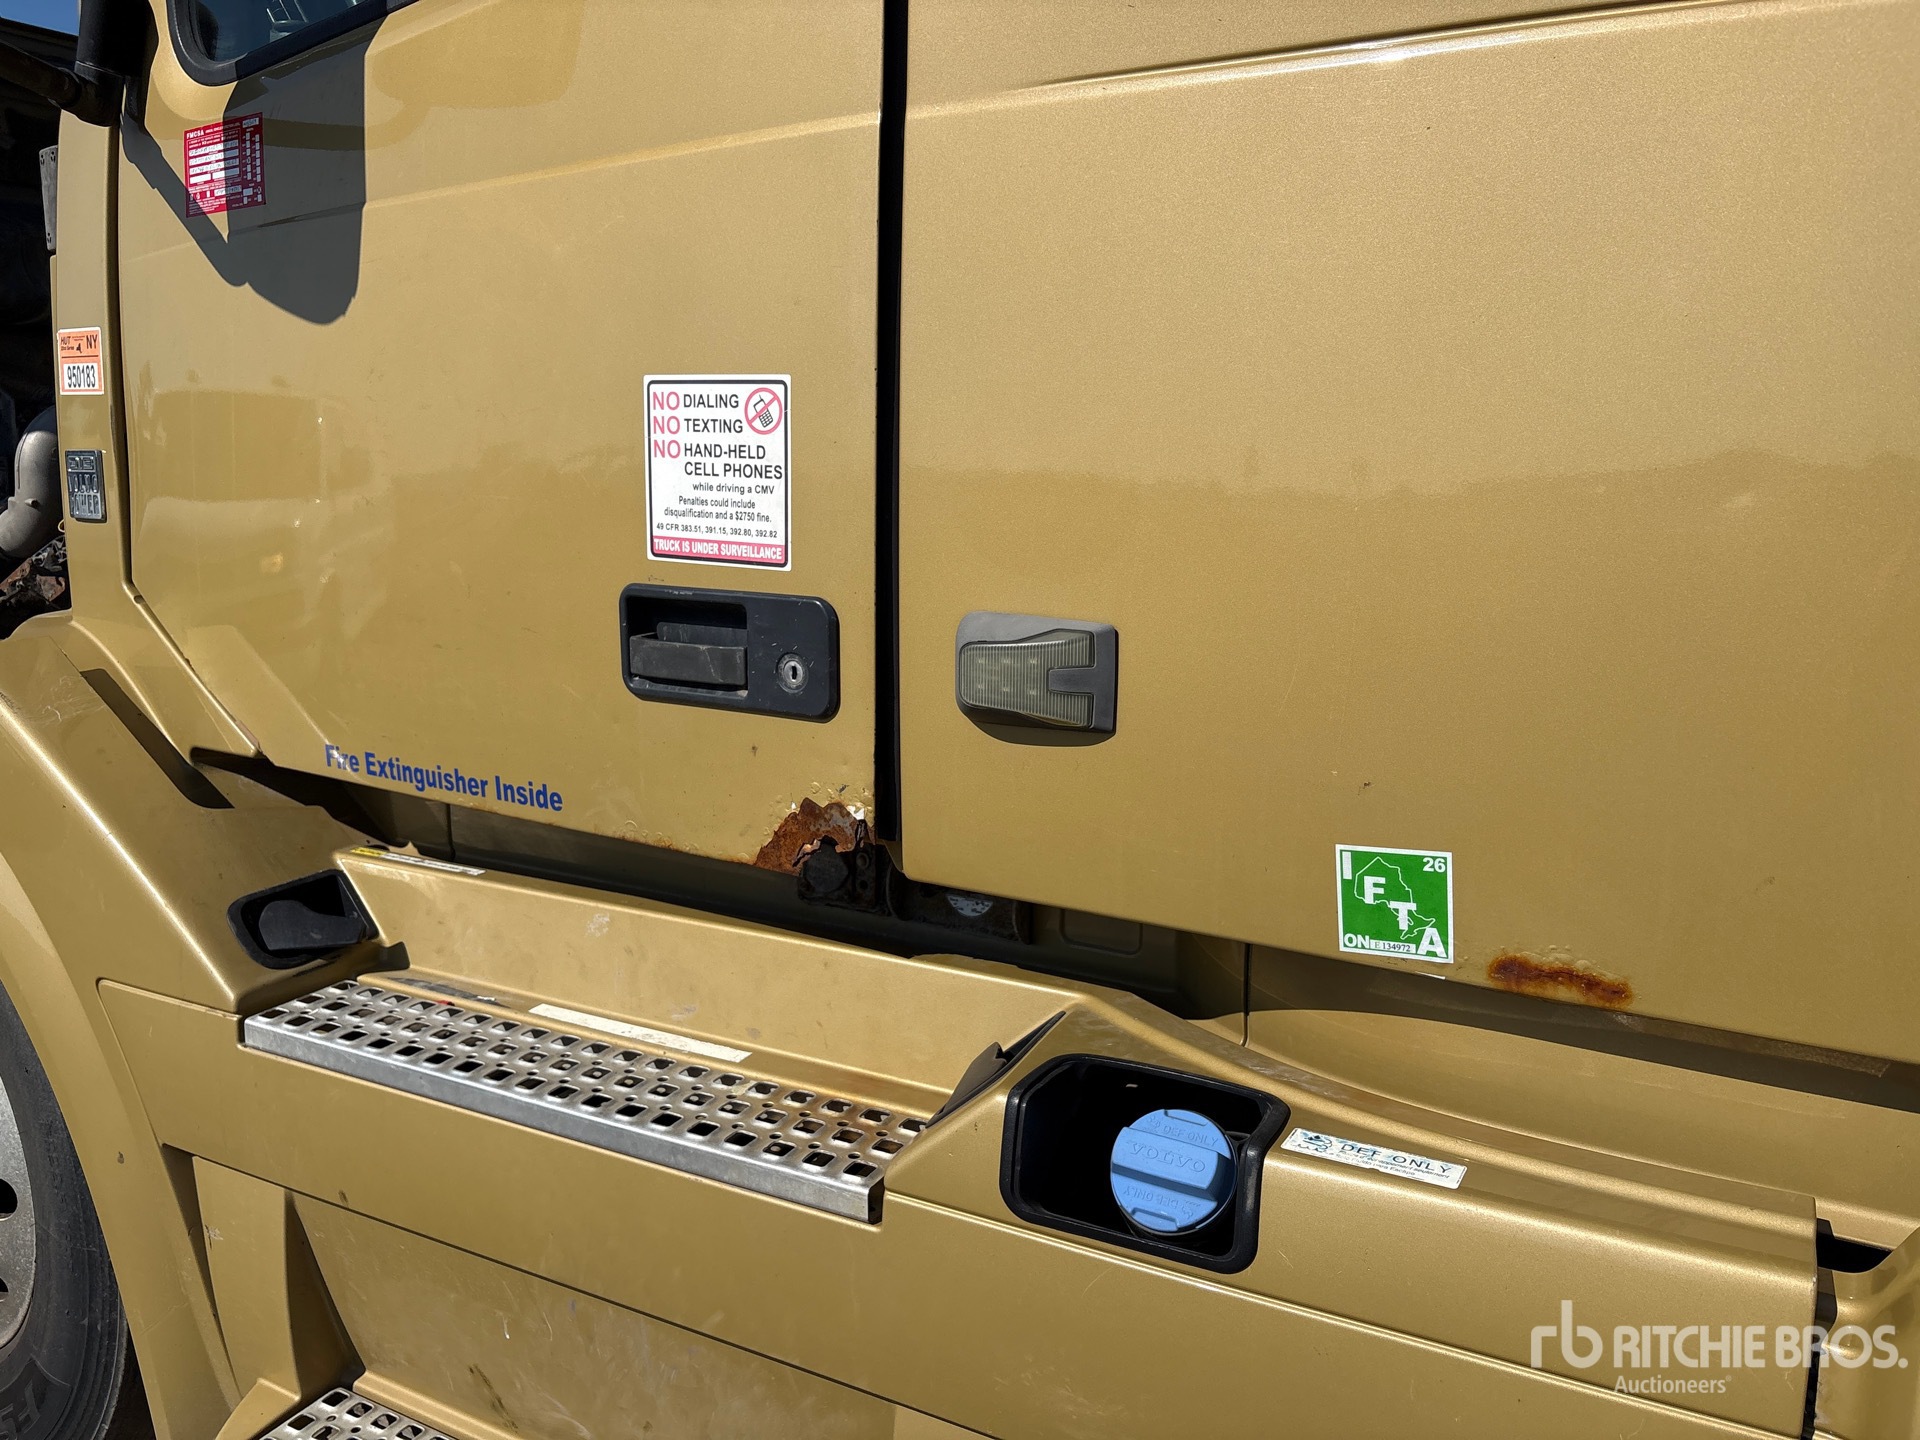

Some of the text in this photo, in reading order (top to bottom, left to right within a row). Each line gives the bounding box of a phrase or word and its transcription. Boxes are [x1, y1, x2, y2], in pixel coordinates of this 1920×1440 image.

[186, 129, 205, 139] FMCSA
[86, 334, 98, 349] NY
[67, 365, 96, 388] 950183
[653, 391, 739, 411] NO DIALING
[653, 415, 743, 435] NO TEXTING
[654, 439, 766, 460] NO HAND-HELD
[684, 461, 783, 480] CELL PHONES
[692, 482, 775, 496] while driving a CMV
[678, 495, 756, 510] Penalties could include
[664, 507, 714, 520] disqualification
[715, 511, 728, 520] and
[735, 511, 755, 522] $2750
[756, 512, 772, 523] fine.
[656, 522, 778, 539] 49 CFR 383.51, 391.15, 392.80, 392.82
[654, 539, 783, 561] TRUCK IS UNDER SURVEILLANCE
[325, 744, 563, 812] Fire Extinguisher Inside
[1422, 857, 1446, 873] 26
[1343, 933, 1371, 949] ON
[1382, 942, 1411, 952] 134972
[1129, 1142, 1206, 1172] VOLVO
[1341, 1143, 1382, 1157] DEF
[1392, 1155, 1451, 1173] ONLY
